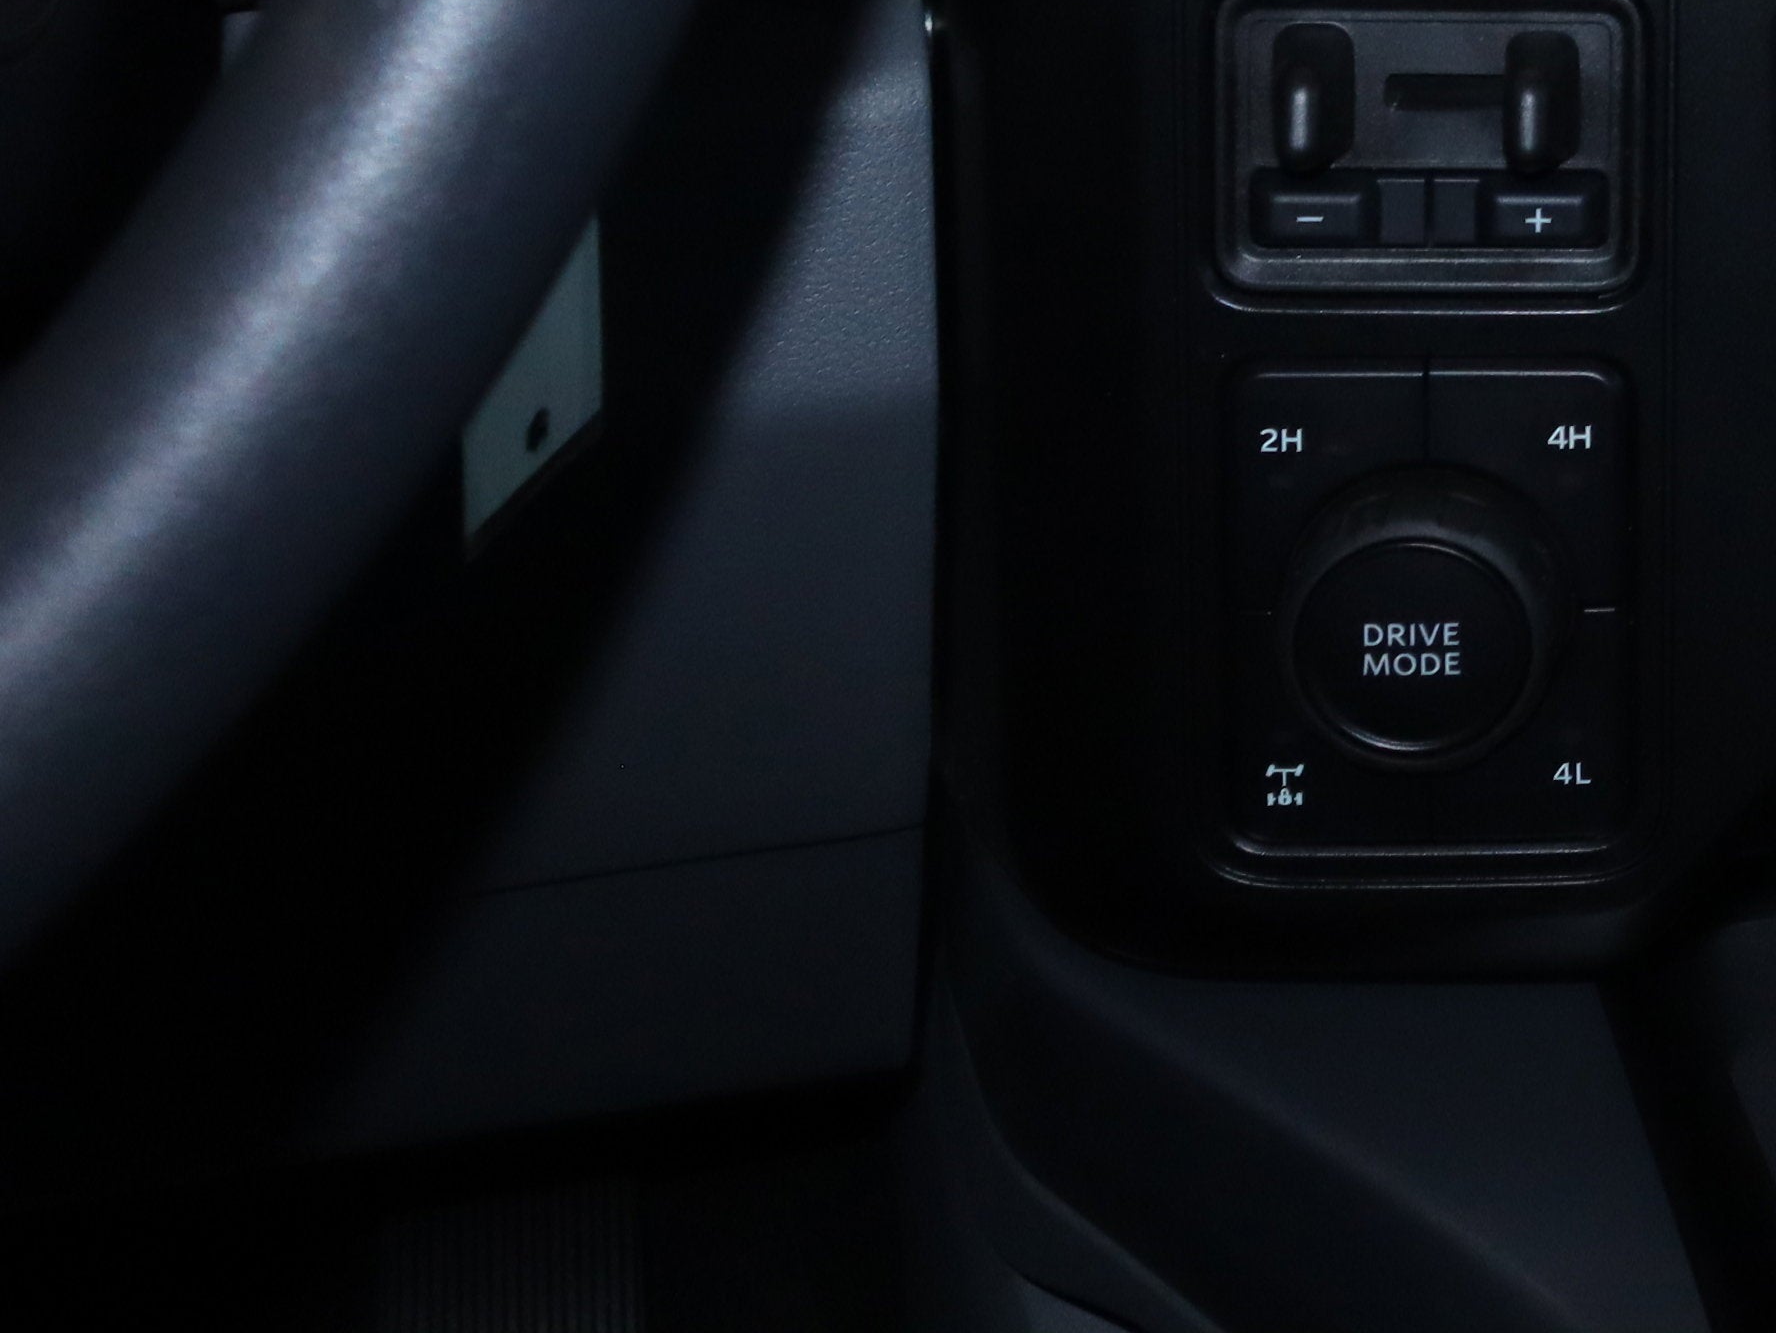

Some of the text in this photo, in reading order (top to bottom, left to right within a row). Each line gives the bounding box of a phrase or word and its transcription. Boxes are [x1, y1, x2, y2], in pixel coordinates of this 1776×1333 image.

[1259, 428, 1304, 453] 2H
[1547, 425, 1592, 451] 4H
[1361, 623, 1461, 648] DRIVE
[1361, 651, 1462, 677] MODE
[1553, 762, 1592, 787] 4L
